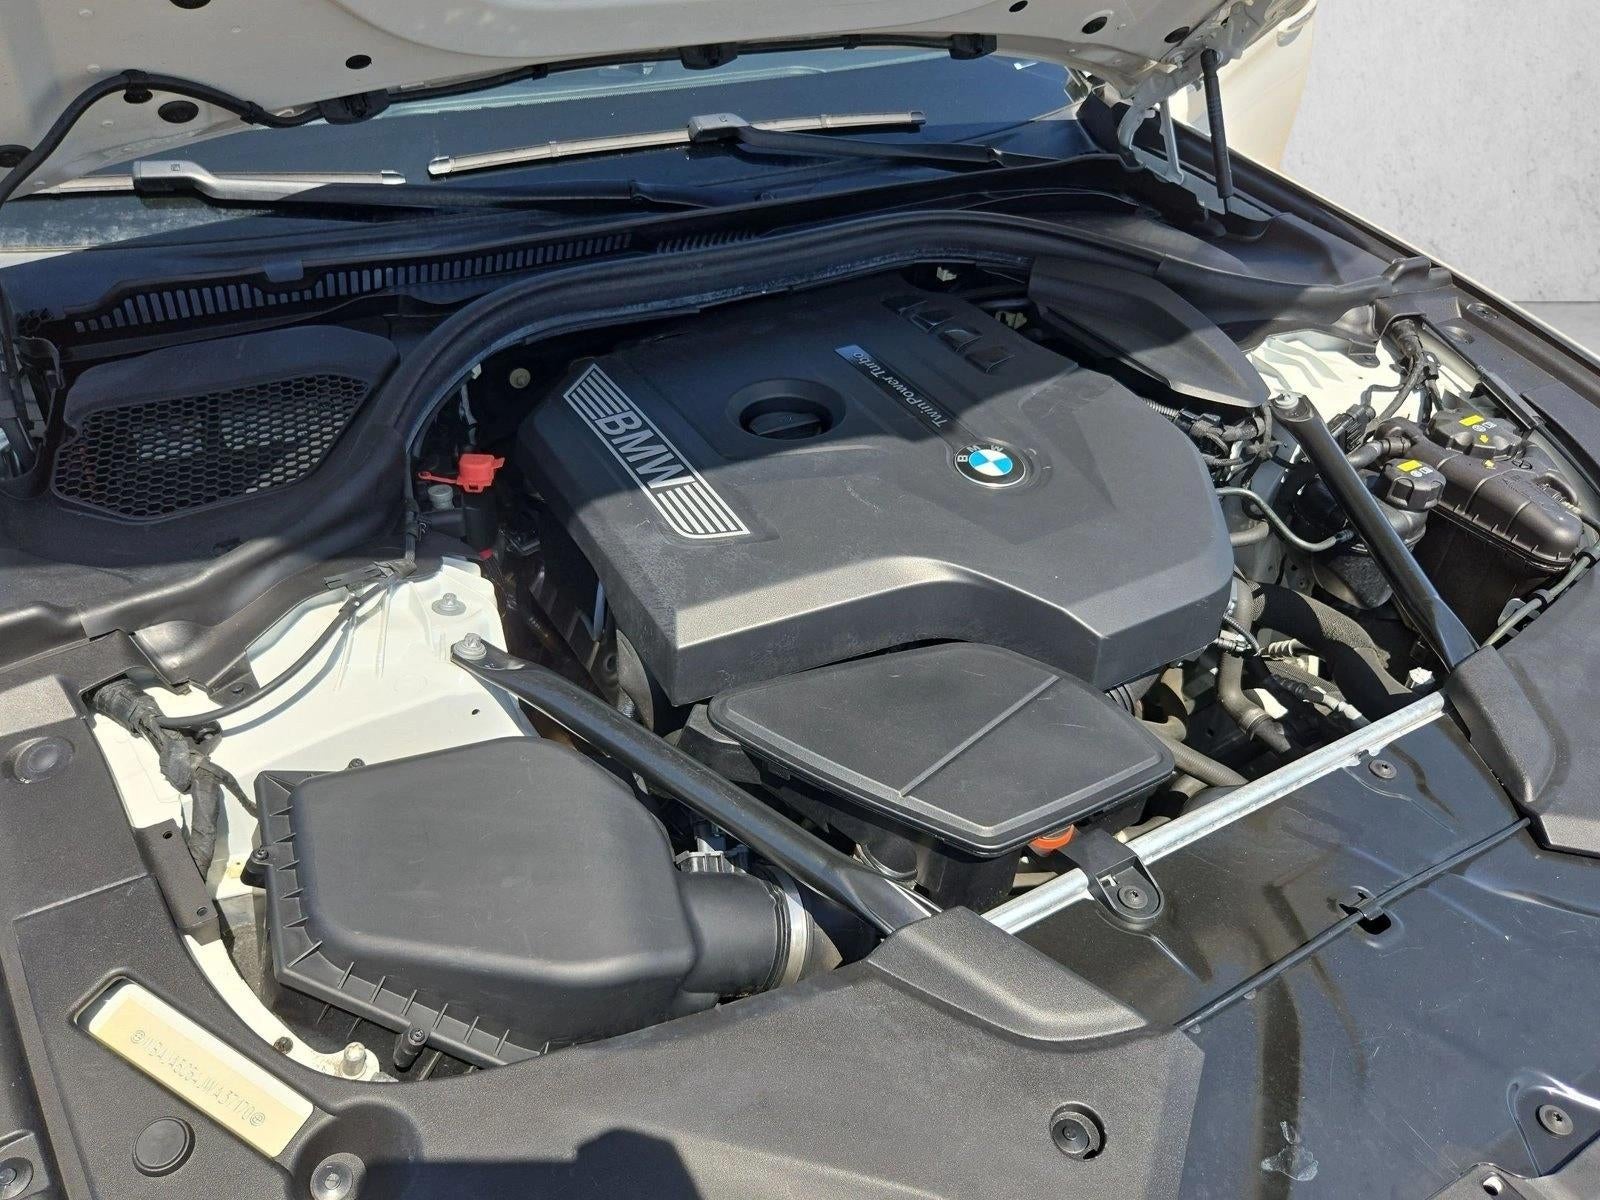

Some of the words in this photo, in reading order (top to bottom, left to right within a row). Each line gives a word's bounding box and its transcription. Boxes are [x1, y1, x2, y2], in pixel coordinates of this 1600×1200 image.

[853, 351, 885, 378] Turbo
[883, 375, 948, 428] TwinPower
[594, 410, 696, 489] BMW
